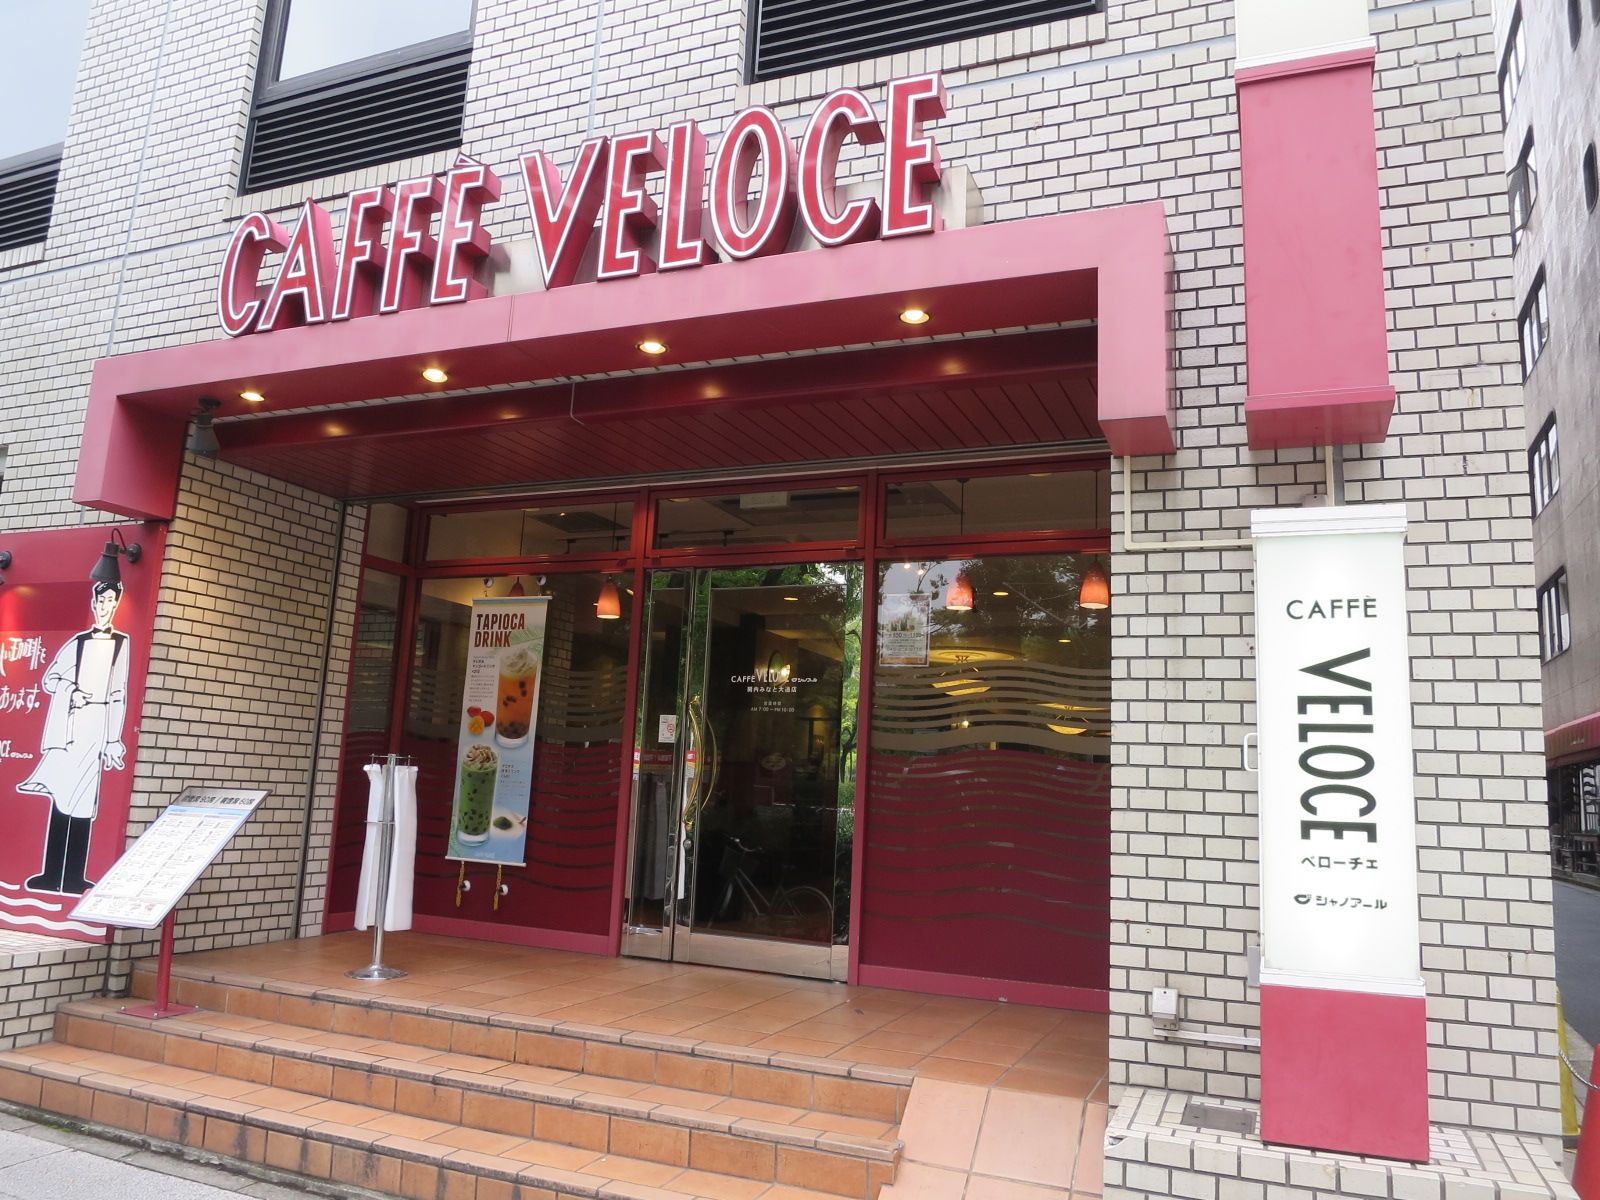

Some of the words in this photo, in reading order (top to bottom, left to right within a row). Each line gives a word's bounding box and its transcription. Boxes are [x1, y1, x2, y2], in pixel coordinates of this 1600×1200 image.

[520, 72, 945, 290] VELOCE
[1286, 595, 1378, 620] CAFFÈ
[476, 613, 525, 631] TAPIOCA
[473, 631, 513, 648] DRINK
[1297, 647, 1378, 844] VELOCE
[1301, 855, 1378, 871] ベローチェ
[1315, 895, 1388, 910] シャノアール
